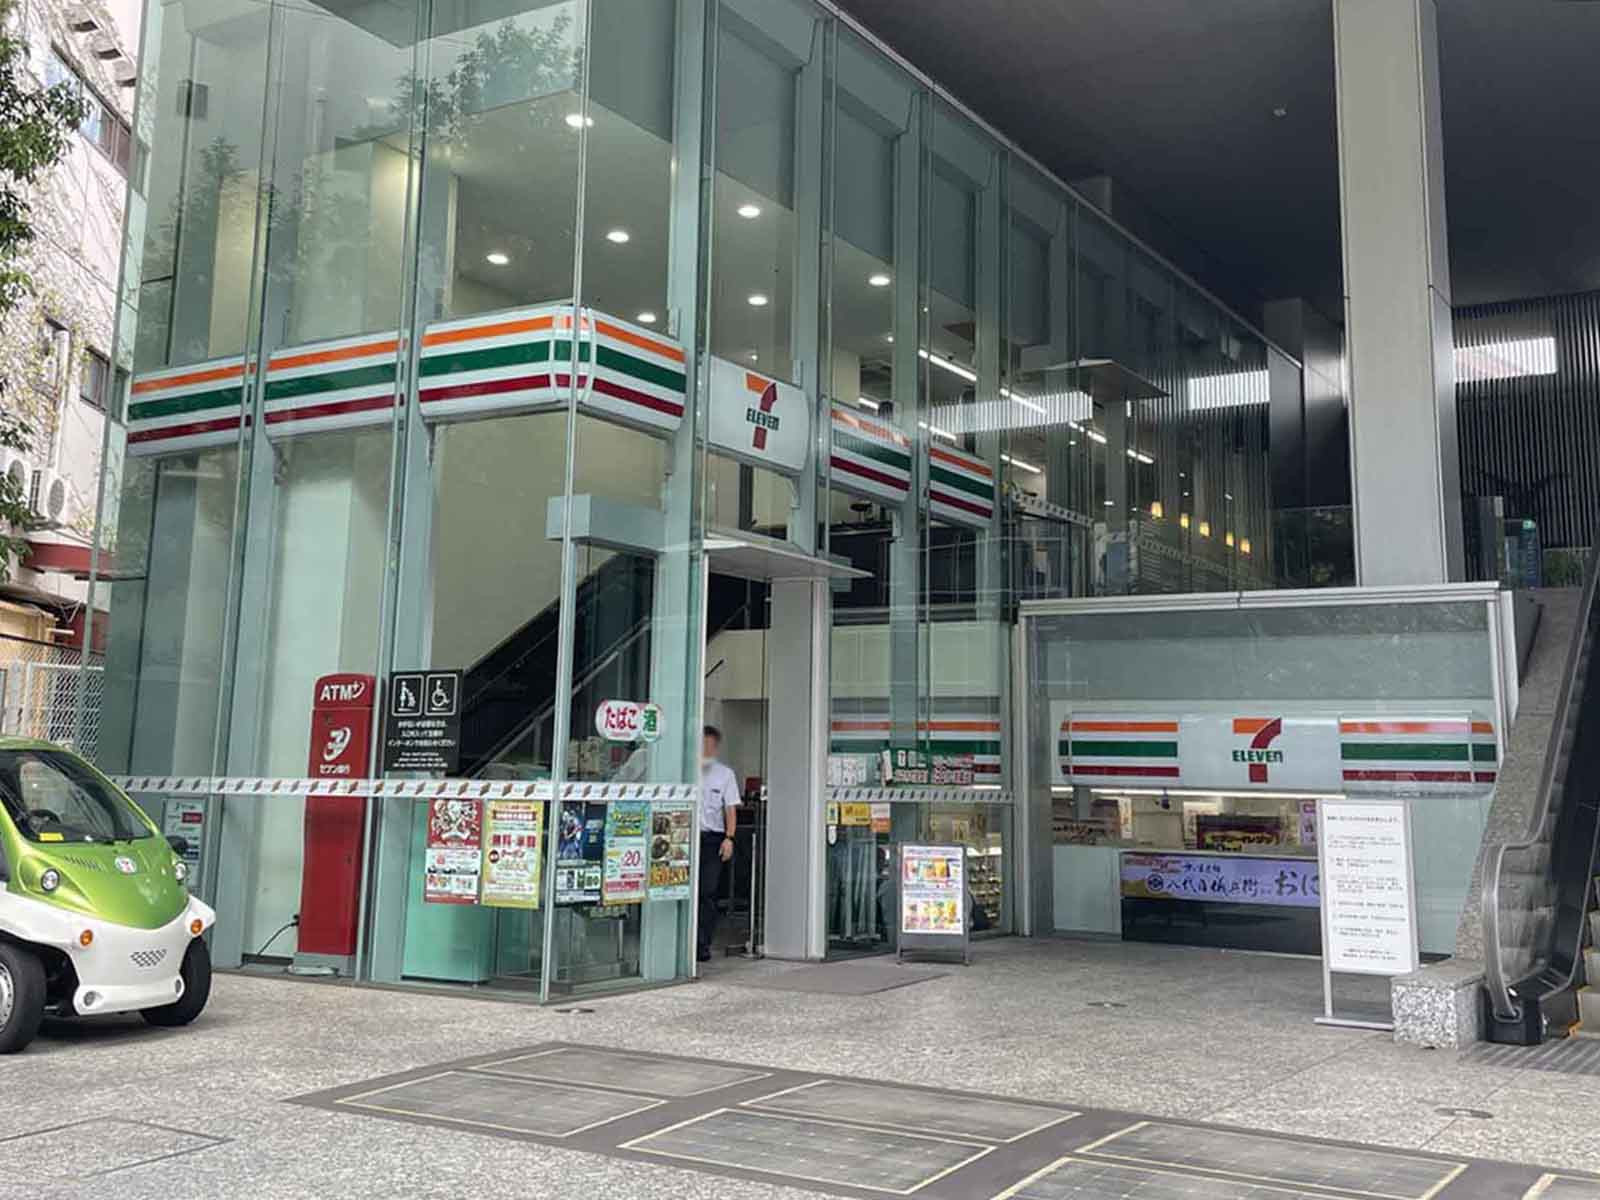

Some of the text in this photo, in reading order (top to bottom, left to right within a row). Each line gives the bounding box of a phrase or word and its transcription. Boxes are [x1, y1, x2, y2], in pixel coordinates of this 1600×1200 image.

[746, 373, 777, 451] 7
[320, 684, 352, 701] ATM
[605, 706, 637, 730] たばこ
[643, 709, 657, 732] 酒
[1233, 717, 1282, 783] 7
